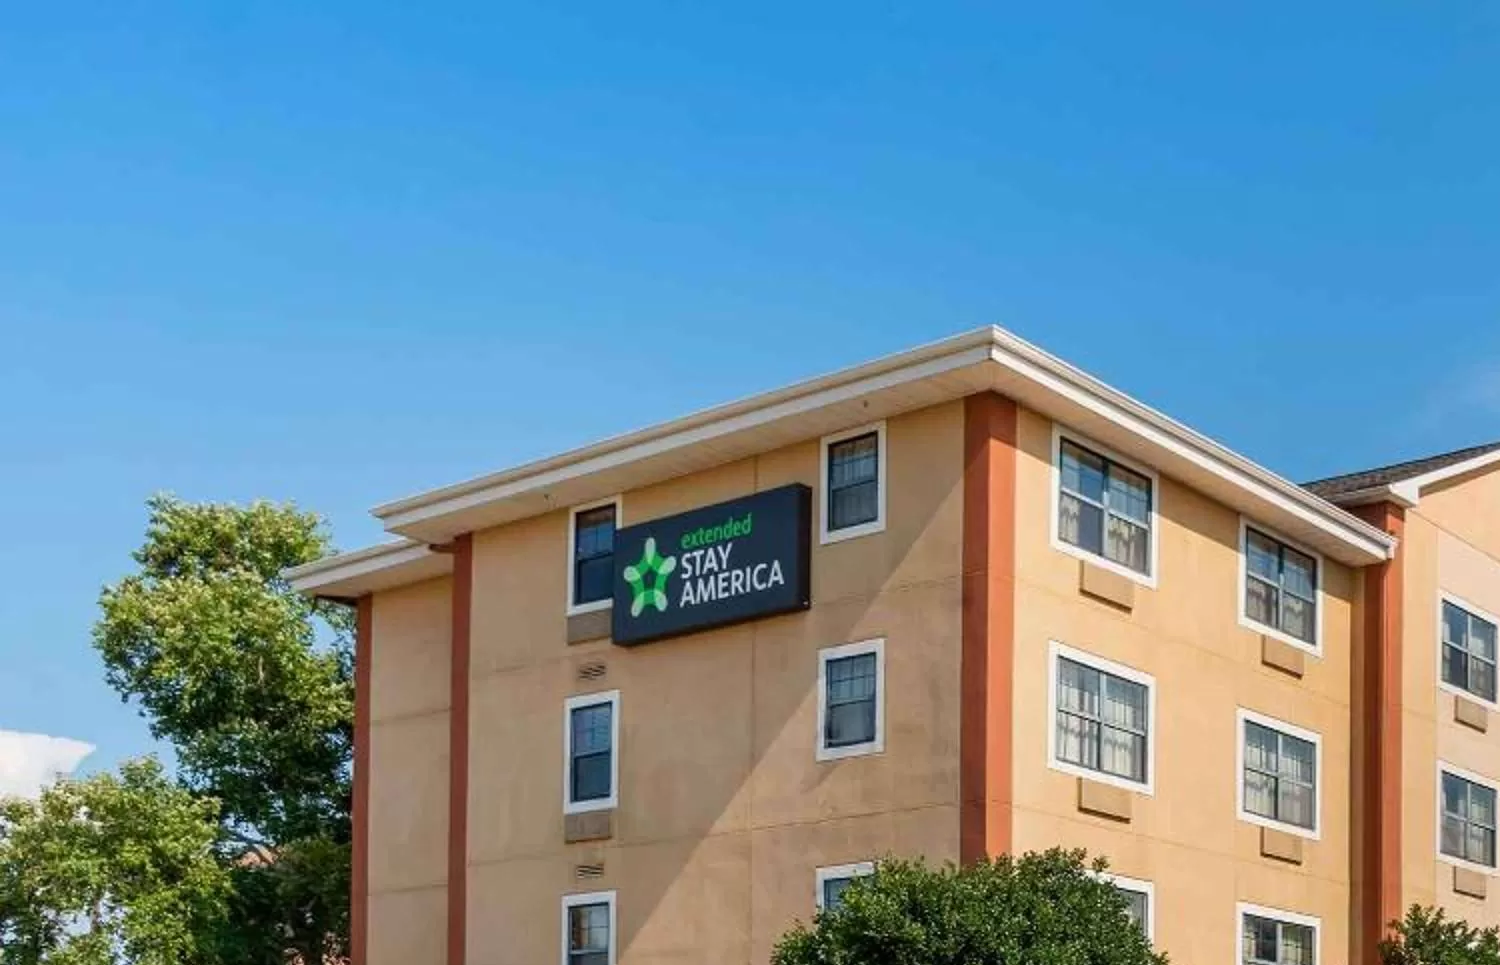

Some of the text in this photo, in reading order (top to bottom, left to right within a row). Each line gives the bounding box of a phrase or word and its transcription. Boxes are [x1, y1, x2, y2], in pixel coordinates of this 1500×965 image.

[681, 512, 752, 549] extended
[681, 542, 732, 579] STAY
[680, 560, 784, 607] AMERICA
